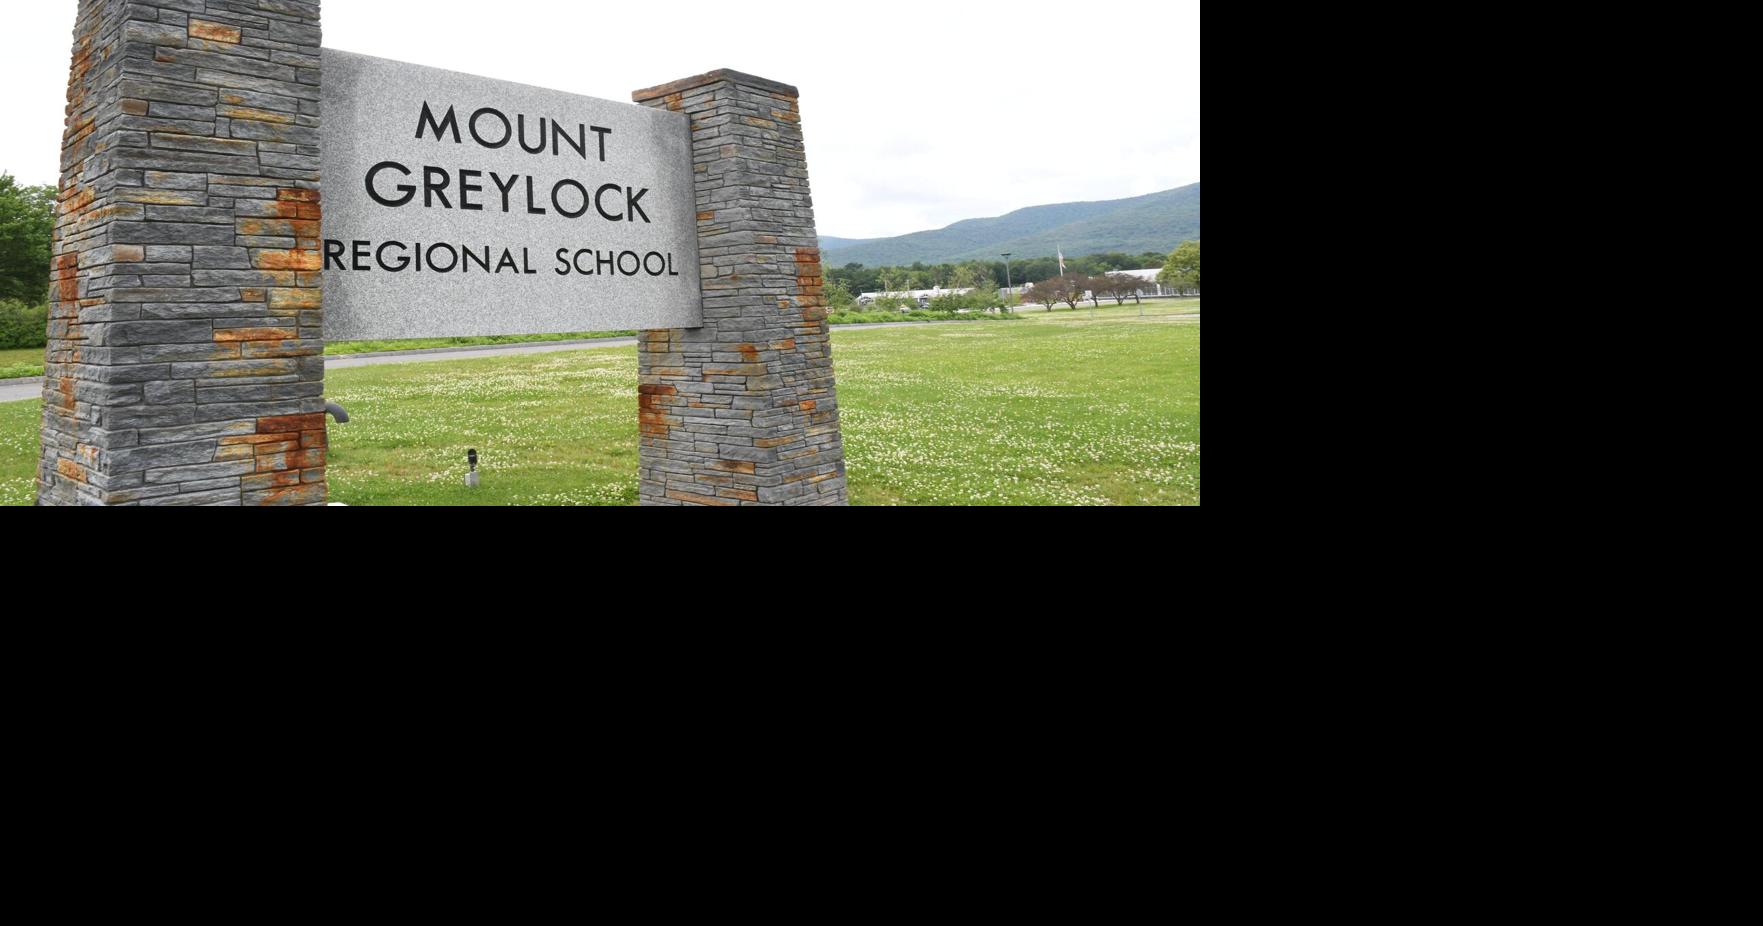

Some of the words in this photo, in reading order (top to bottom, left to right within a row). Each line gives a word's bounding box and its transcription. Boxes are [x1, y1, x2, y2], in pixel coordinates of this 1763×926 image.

[414, 100, 612, 162] MOUNT
[364, 160, 651, 224] GREYLOCK
[323, 238, 537, 273] REGIONAL
[554, 247, 679, 277] SCHOOL
